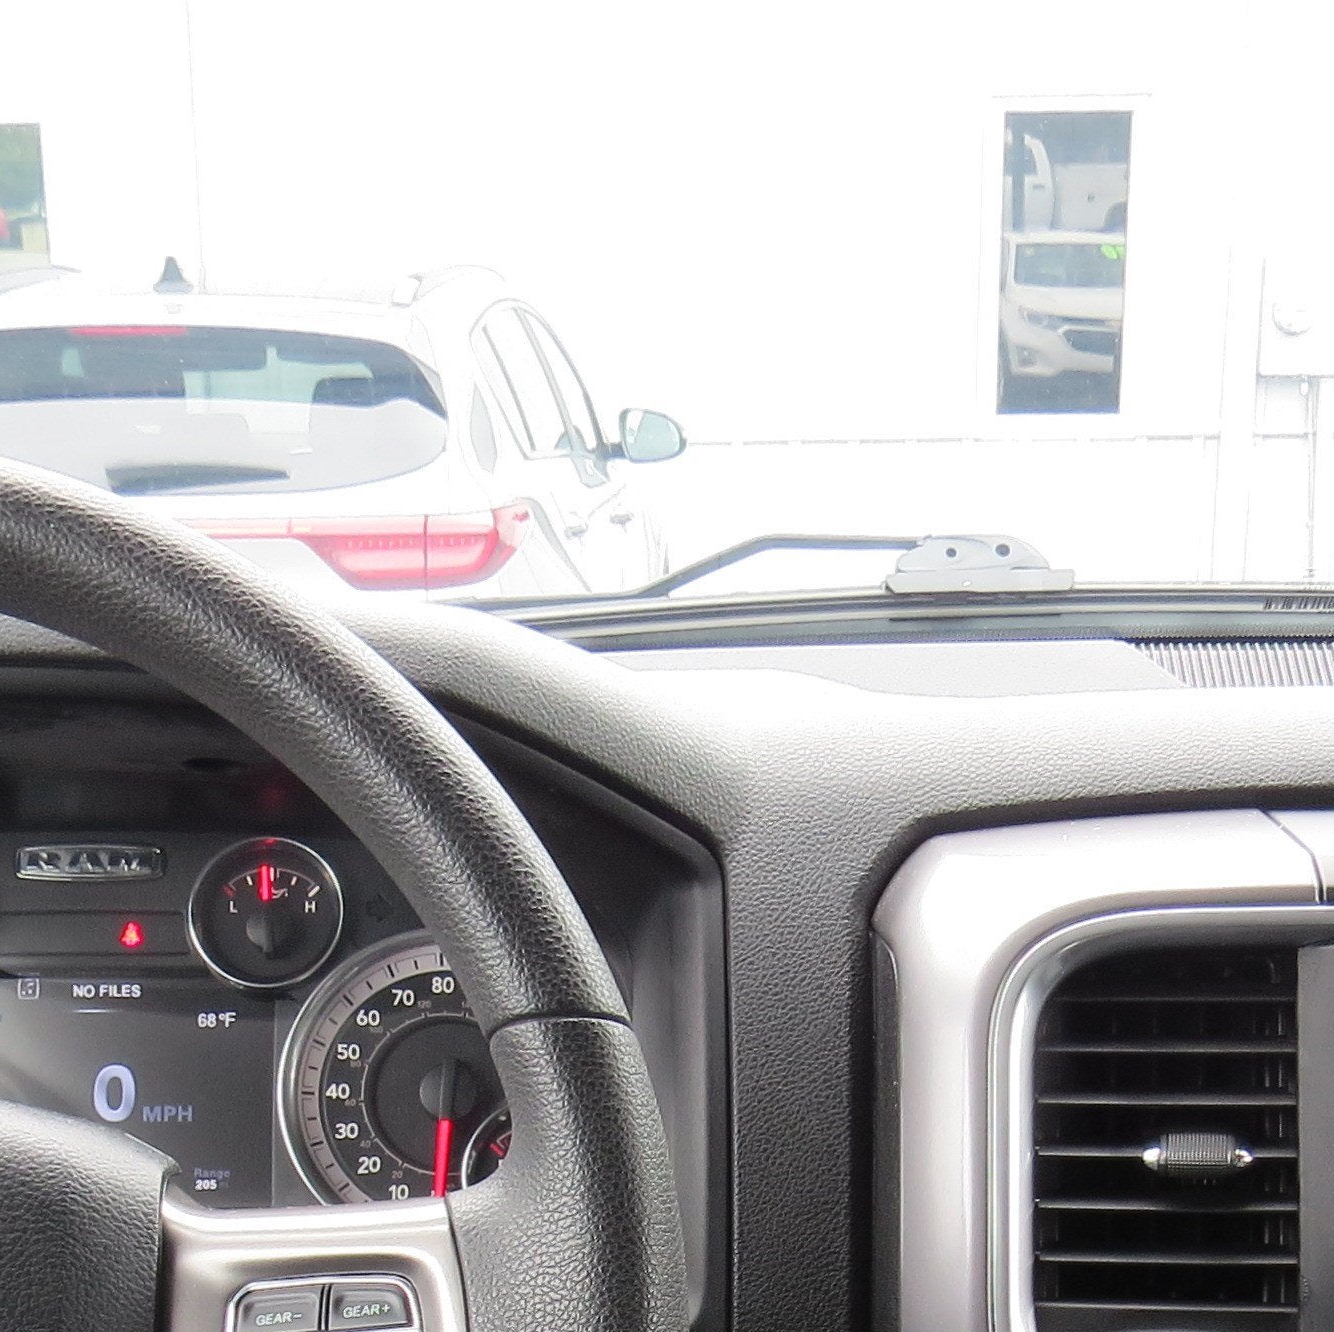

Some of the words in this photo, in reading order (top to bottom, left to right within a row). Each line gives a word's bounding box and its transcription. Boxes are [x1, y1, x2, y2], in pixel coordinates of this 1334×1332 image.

[20, 850, 153, 873] RAM
[230, 901, 237, 913] L
[305, 901, 315, 912] H
[73, 985, 96, 997] NO
[100, 985, 141, 997] FILES
[432, 977, 454, 993] 80
[392, 989, 414, 1007] 70
[356, 1010, 380, 1027] 60
[337, 1044, 360, 1060] 50
[94, 1063, 136, 1122] 0
[143, 1105, 193, 1122] MPH
[326, 1084, 350, 1099] 40
[335, 1123, 358, 1139] 30
[357, 1157, 380, 1174] 20
[389, 1185, 409, 1200] 10
